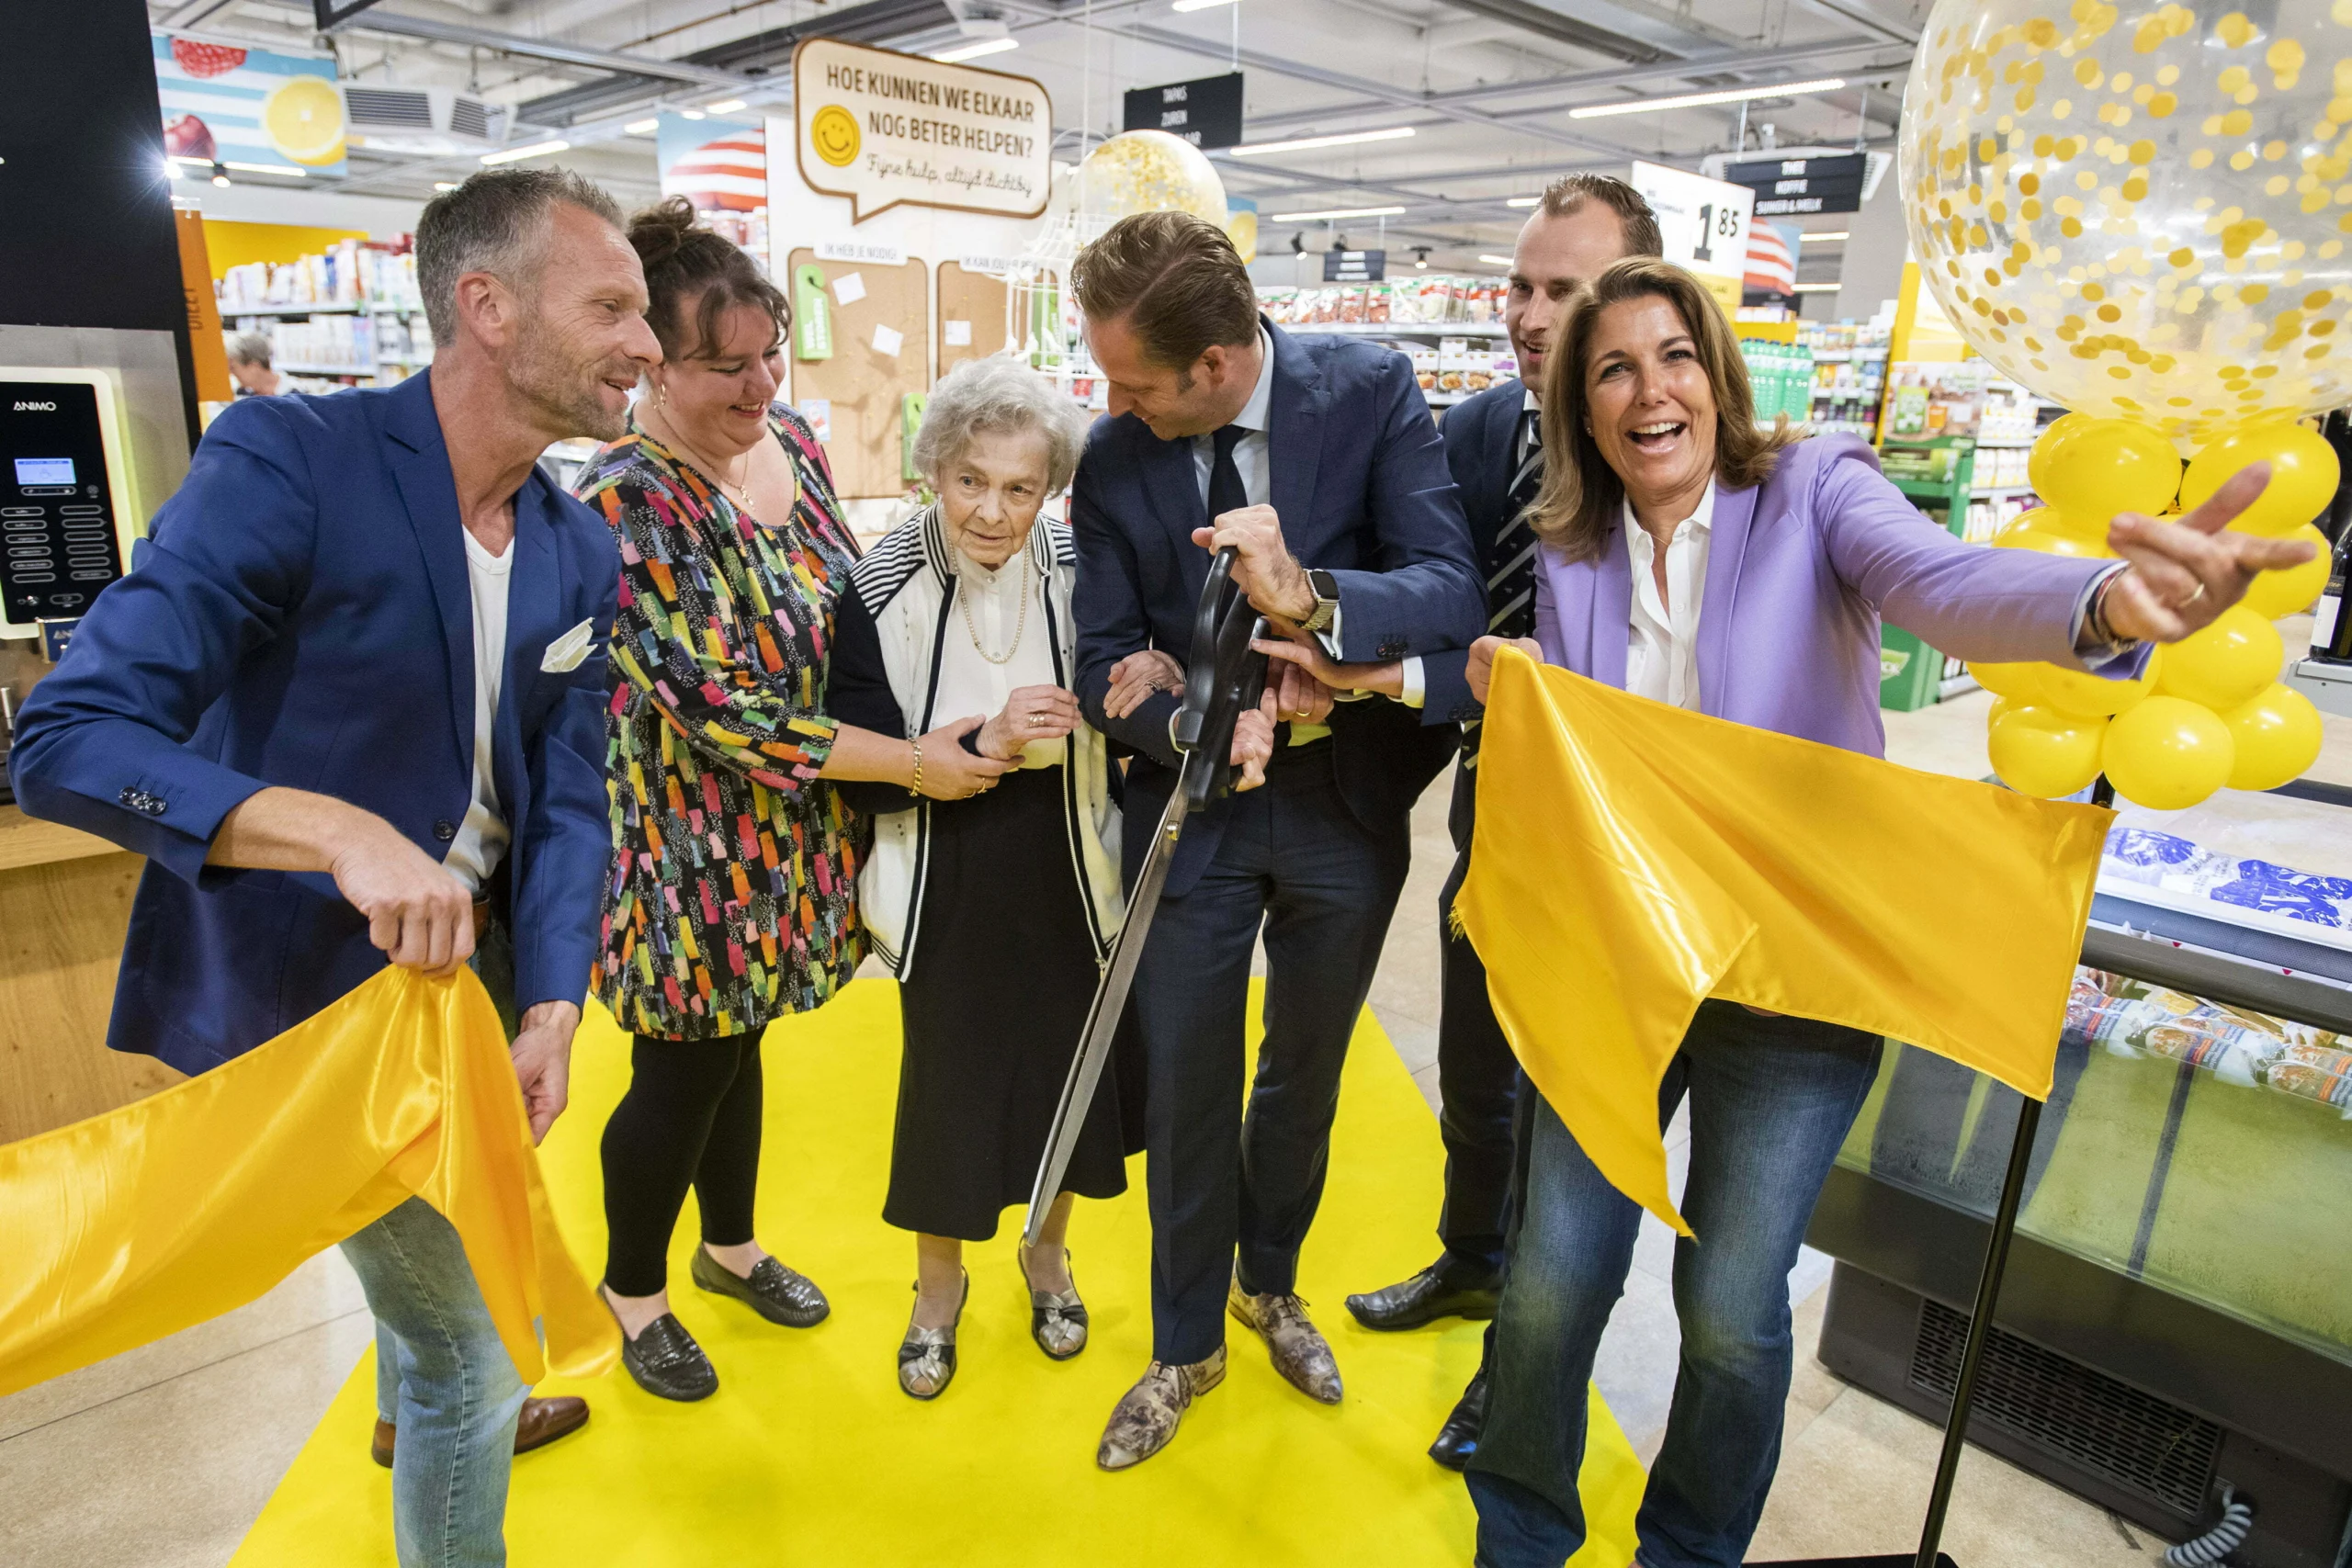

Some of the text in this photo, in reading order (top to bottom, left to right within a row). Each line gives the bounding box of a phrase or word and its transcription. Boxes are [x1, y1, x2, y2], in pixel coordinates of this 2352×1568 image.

[827, 63, 1035, 122] HOE KUNNEN WE ELKAAR
[869, 110, 1034, 158] NOG BETER HELPEN?
[905, 161, 942, 185] hulp,
[945, 165, 982, 190] altijd
[1693, 204, 1739, 262] 1 85
[13, 400, 57, 412] ANIMO
